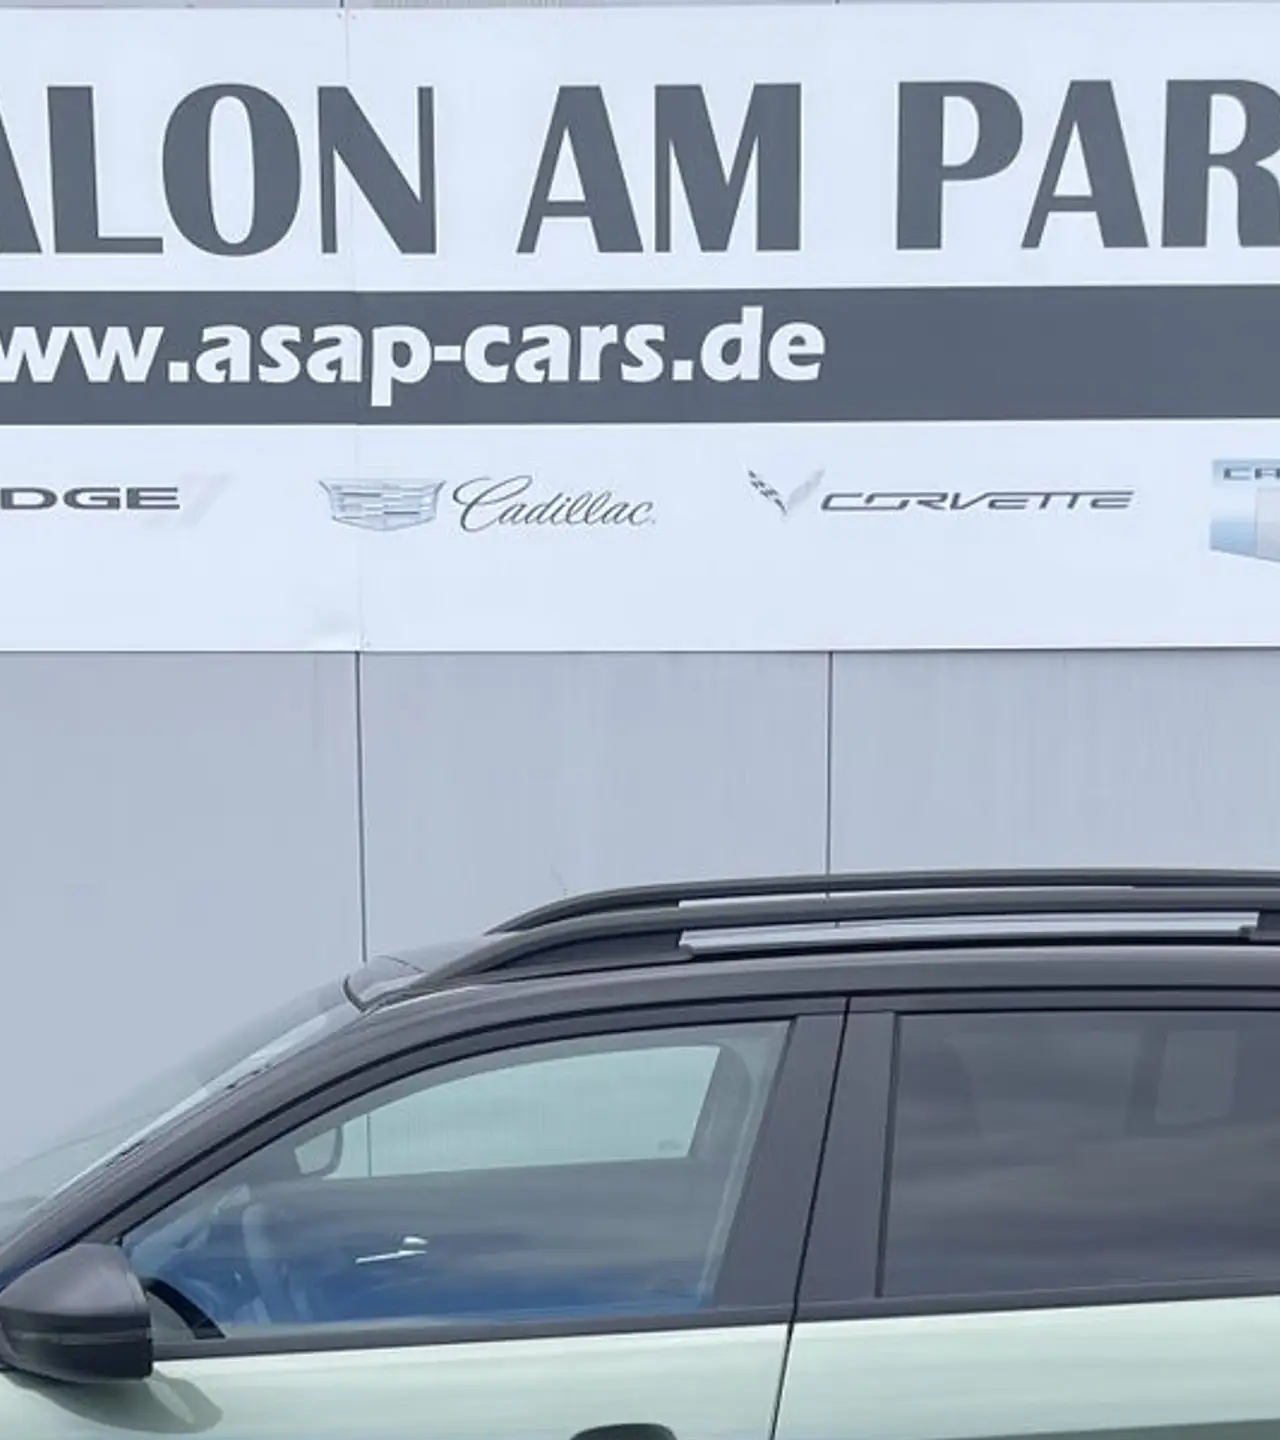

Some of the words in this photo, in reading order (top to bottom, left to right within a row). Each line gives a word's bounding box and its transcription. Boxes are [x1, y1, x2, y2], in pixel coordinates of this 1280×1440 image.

[516, 82, 802, 254] AM
[452, 474, 655, 533] Cadillac
[820, 491, 1135, 511] CORVETTE
